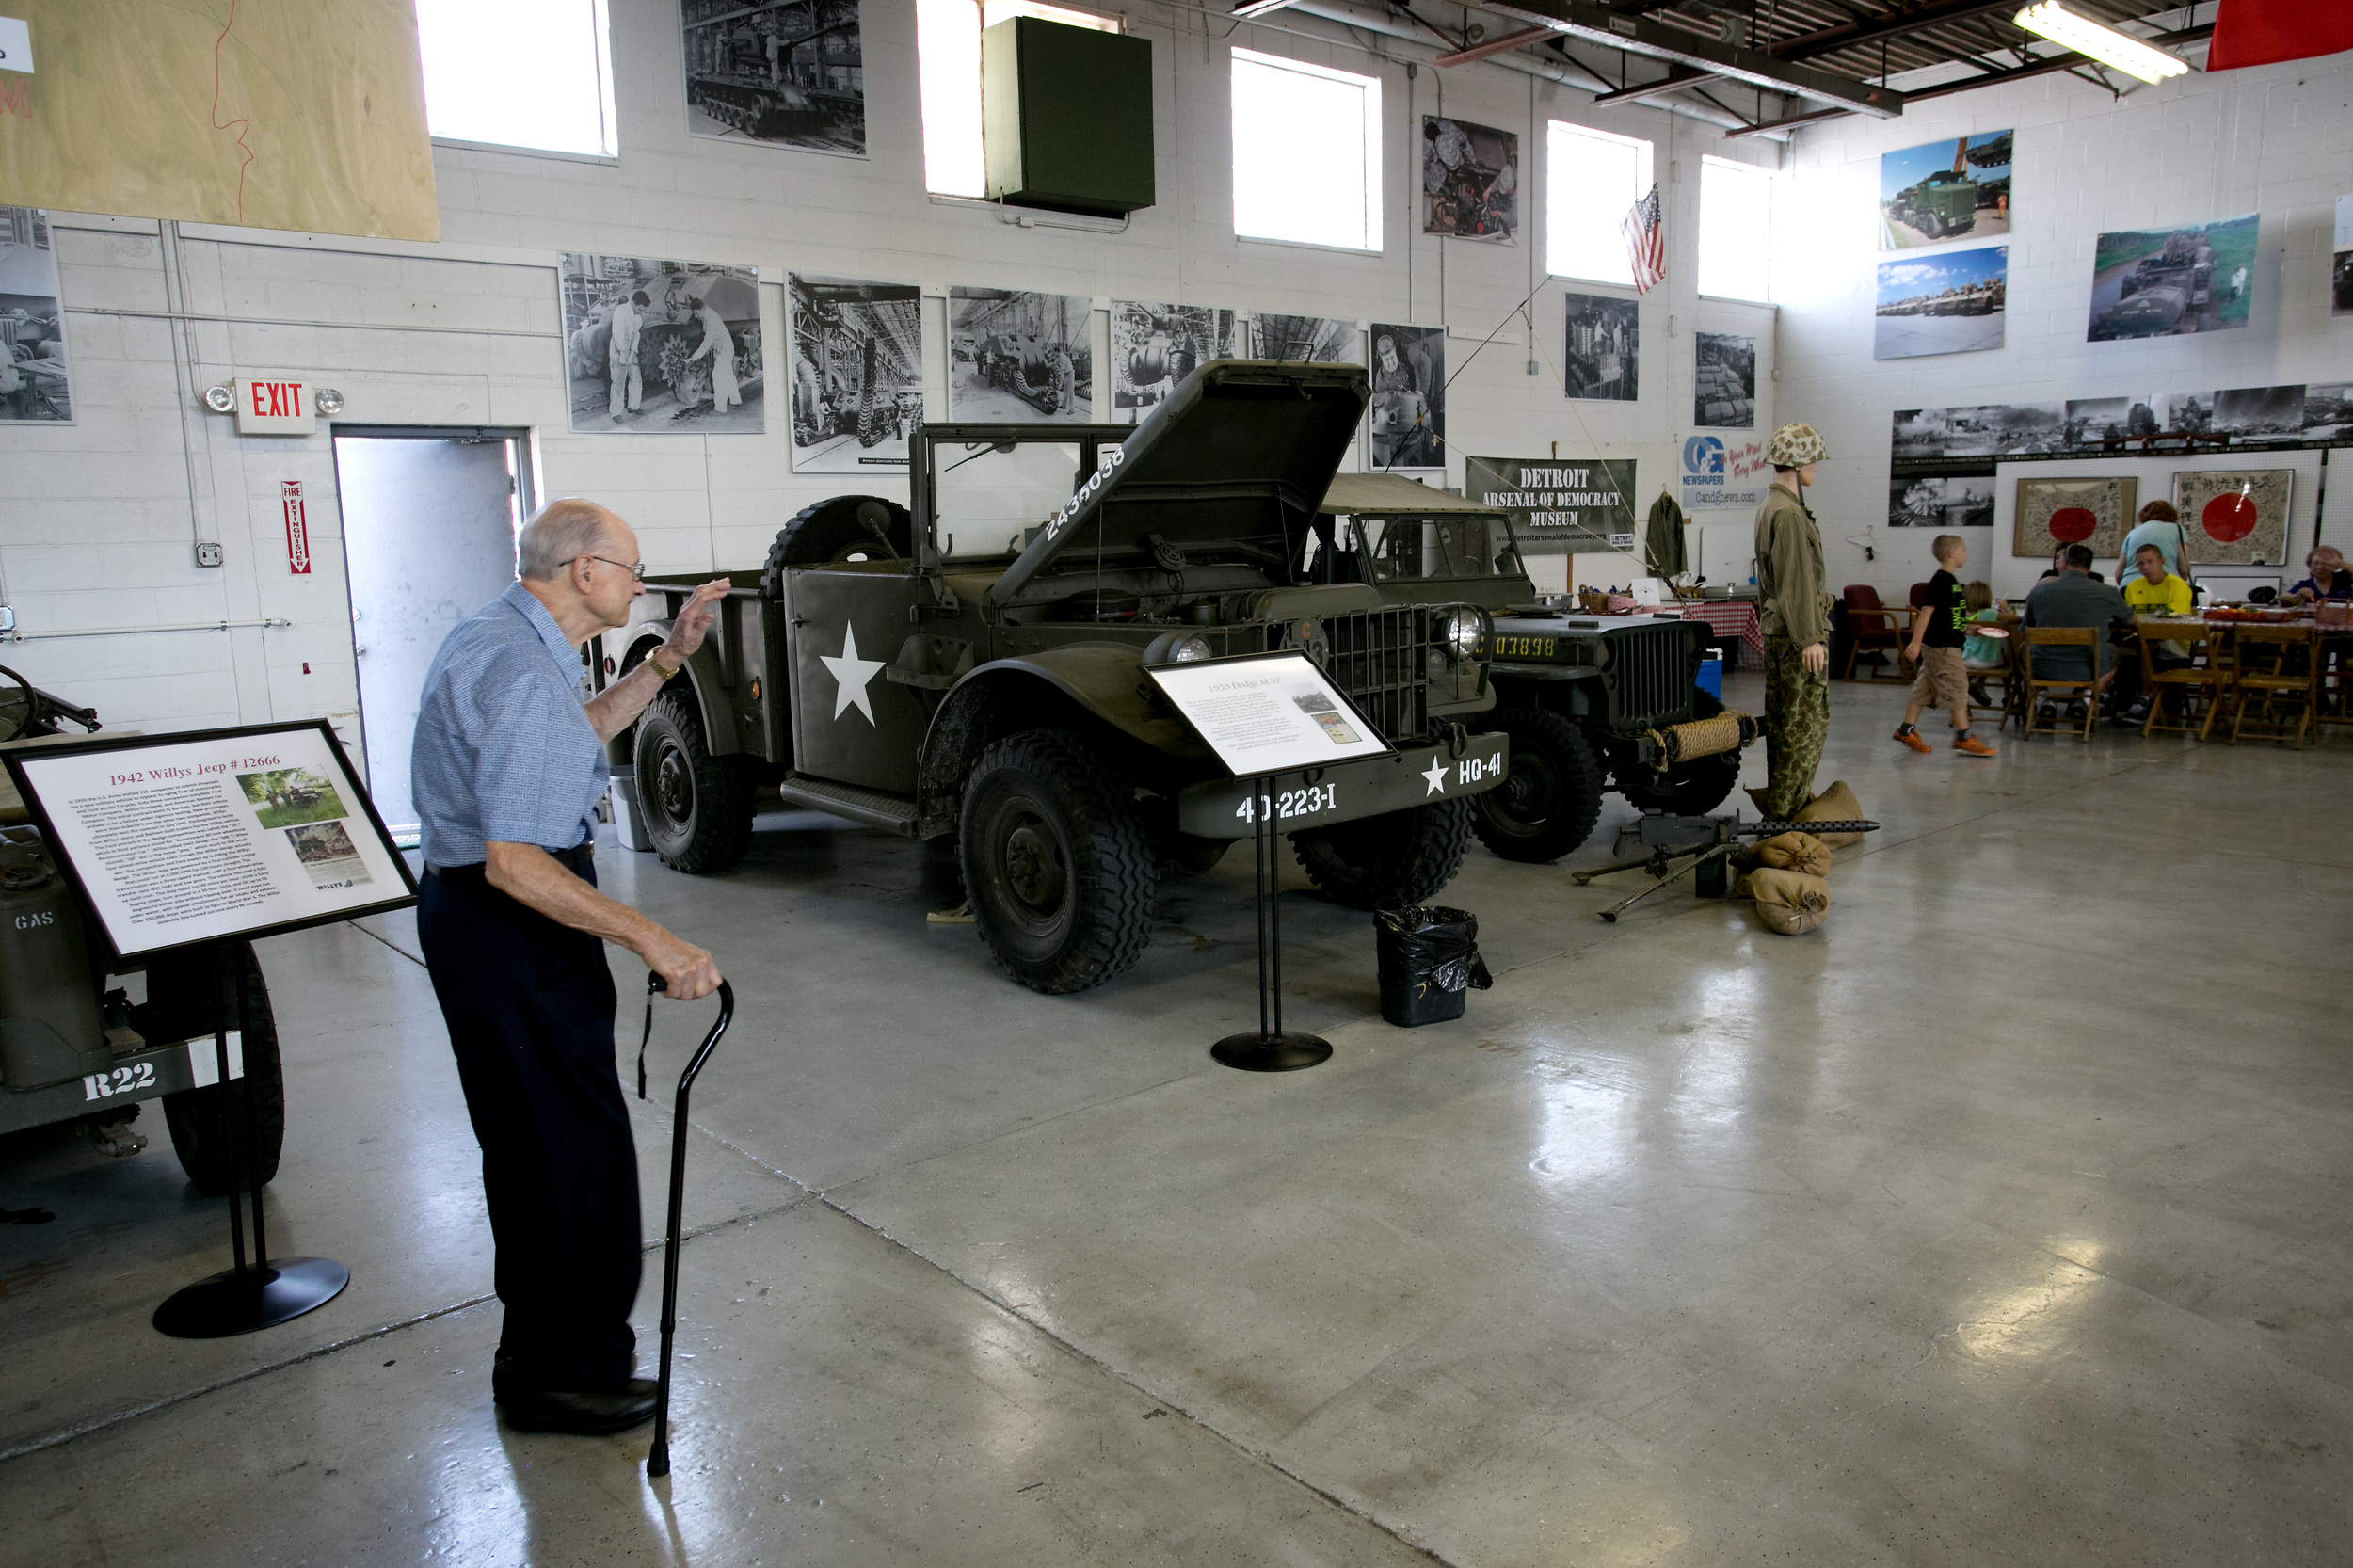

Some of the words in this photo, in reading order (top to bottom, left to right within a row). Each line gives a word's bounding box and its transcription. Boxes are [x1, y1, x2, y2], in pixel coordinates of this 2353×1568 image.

[251, 382, 302, 417] EXIT
[1520, 468, 1589, 488] DETROIT
[1682, 475, 1724, 485] NEWSPAPERS
[284, 488, 301, 497] FIRE
[1045, 447, 1125, 542] 2436038
[1483, 492, 1537, 507] ARSENAL
[1539, 492, 1553, 507] OF
[1557, 492, 1620, 507] DEMOCRACY
[1530, 512, 1578, 527] MUSEUM
[291, 500, 303, 567] EXTINGUISHER
[1302, 621, 1311, 639] C
[1496, 637, 1554, 656] 03898
[1209, 684, 1230, 692] 1953
[1232, 680, 1259, 689] Dodge
[110, 772, 144, 786] 1942
[148, 767, 192, 780] Willys
[197, 762, 226, 775] Jeep
[230, 759, 238, 769] #
[242, 755, 280, 768] 12666
[1459, 752, 1501, 784] HQ-41
[15, 912, 53, 929] GAS
[83, 1062, 156, 1101] R22
